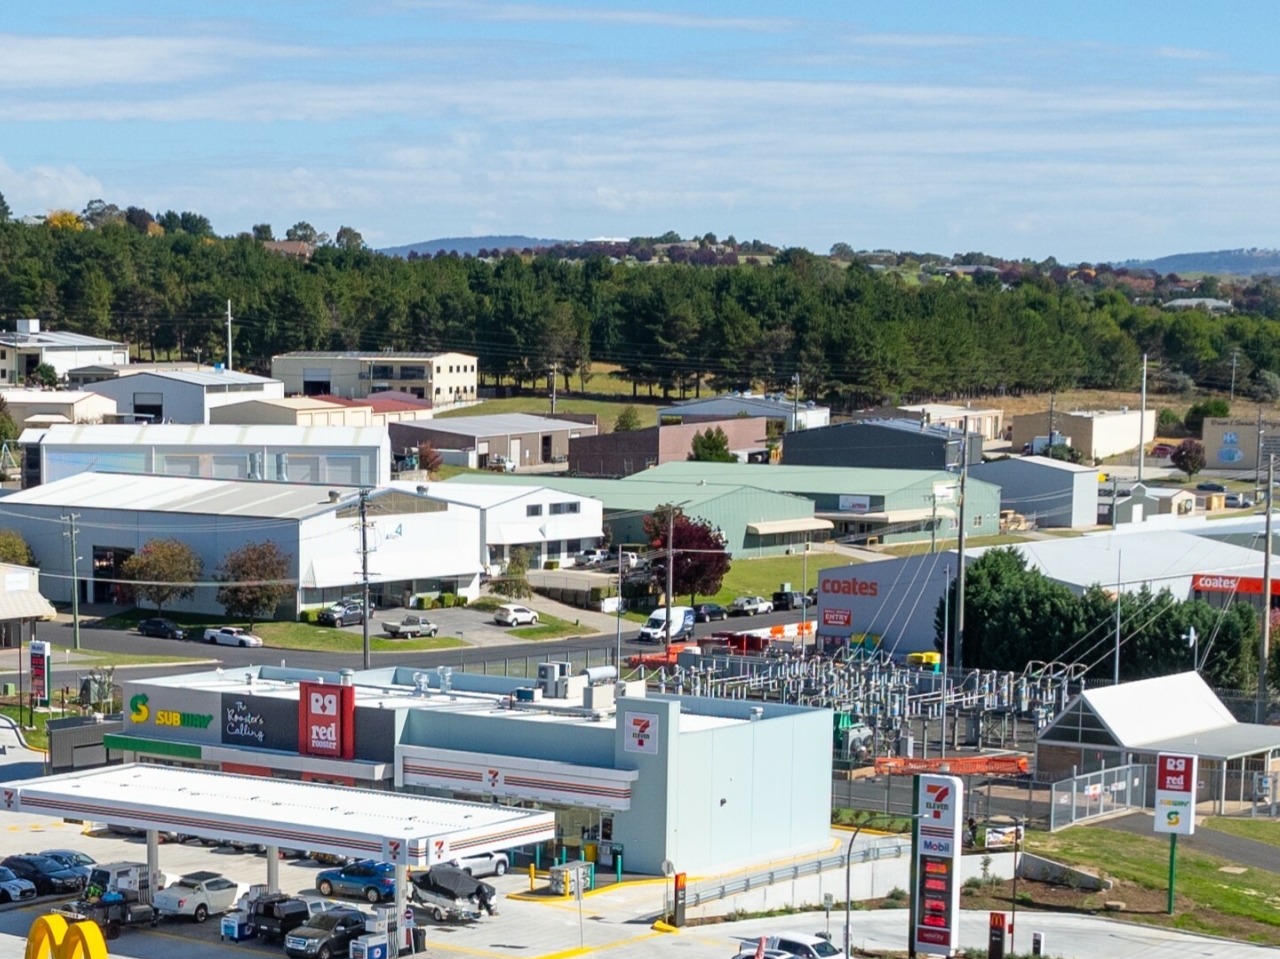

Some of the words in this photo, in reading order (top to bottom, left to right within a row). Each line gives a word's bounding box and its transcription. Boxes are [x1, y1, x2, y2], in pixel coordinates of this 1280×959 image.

[822, 578, 878, 597] coates
[1199, 576, 1236, 588] coates
[825, 614, 850, 622] ENTRY
[235, 701, 247, 711] The
[155, 710, 213, 729] SUBWAY
[227, 708, 264, 726] Rooster's
[227, 722, 265, 742] Calling
[311, 723, 336, 741] red
[311, 740, 337, 749] rooster
[1166, 775, 1184, 785] red
[924, 840, 950, 852] Mobil
